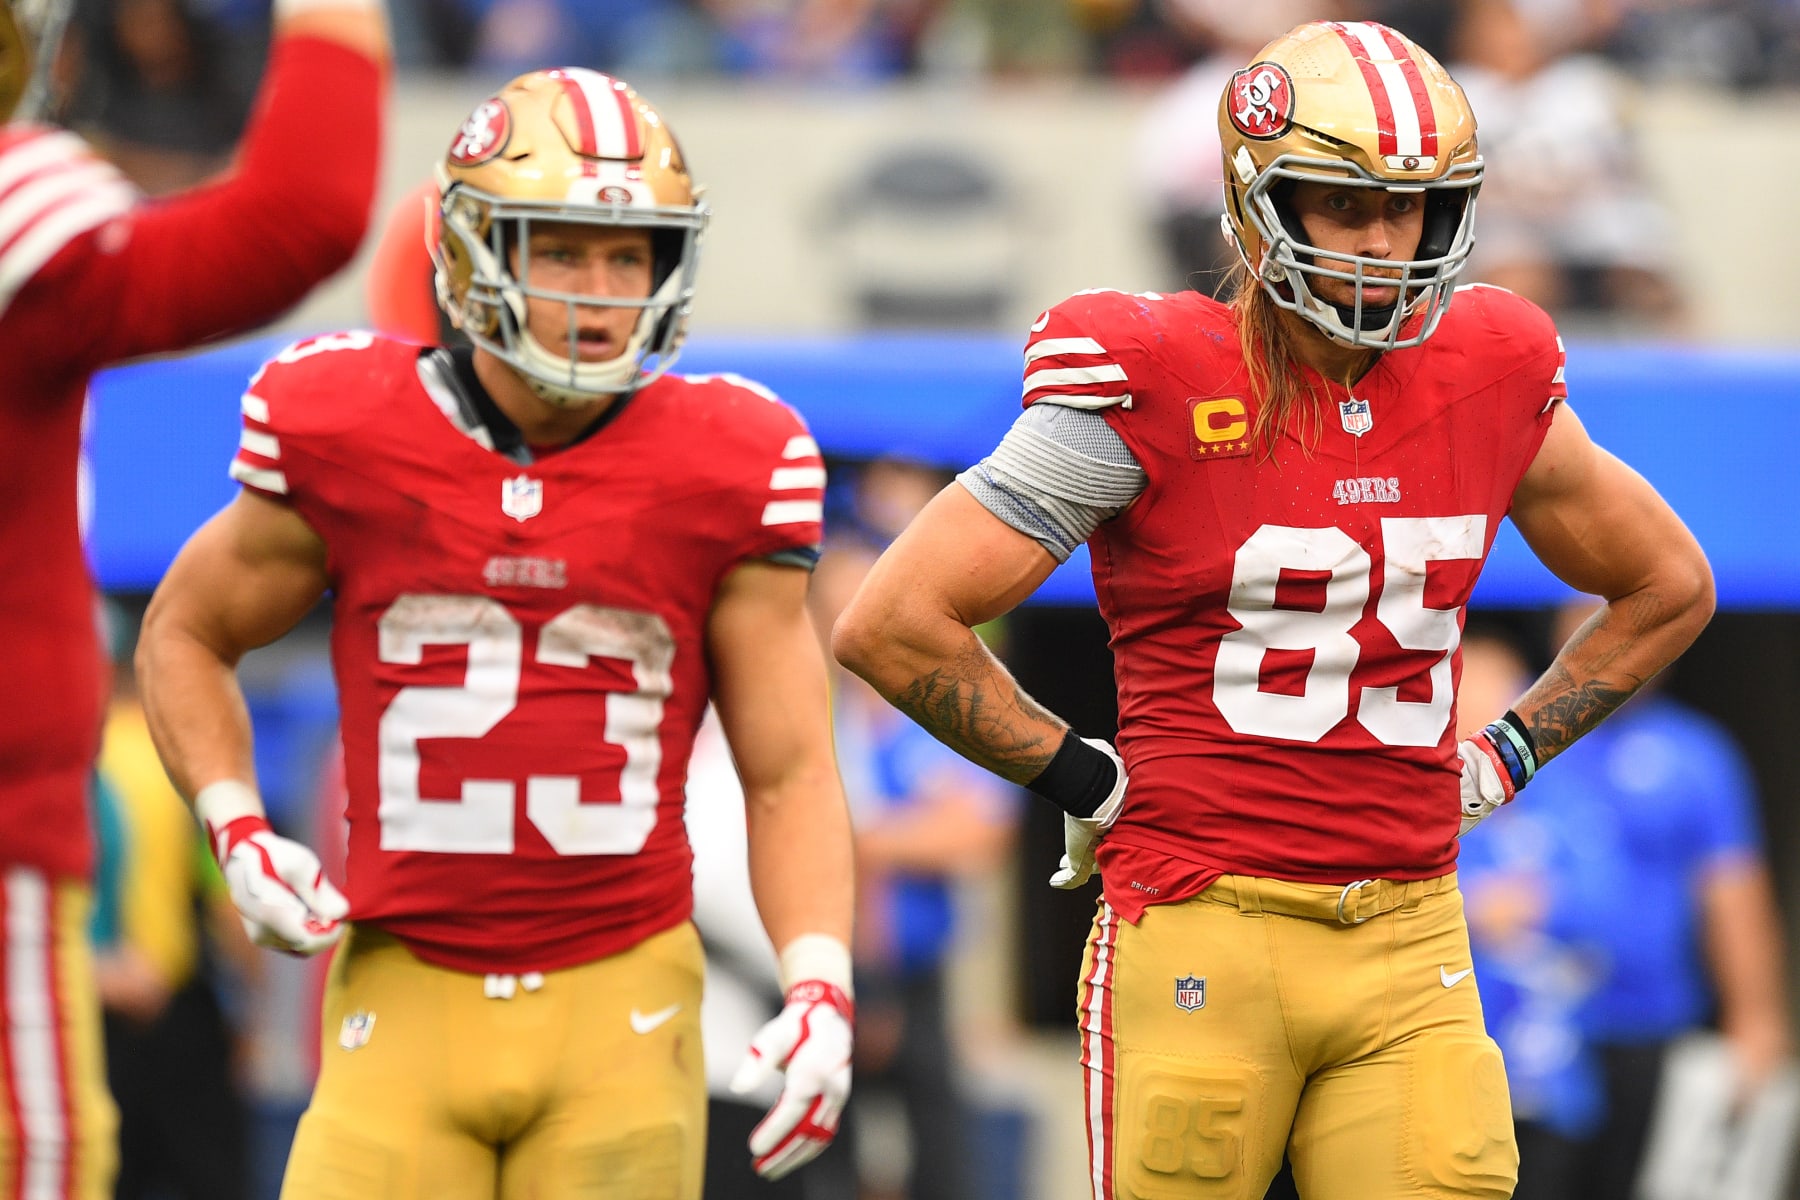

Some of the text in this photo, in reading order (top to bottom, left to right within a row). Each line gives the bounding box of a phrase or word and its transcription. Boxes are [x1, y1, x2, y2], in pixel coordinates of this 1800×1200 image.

[1193, 398, 1247, 443] C
[1346, 414, 1368, 430] NFL
[1332, 476, 1401, 505] 49ERS
[1212, 514, 1488, 747] 85
[377, 593, 677, 856] 23
[1130, 881, 1160, 896] DRI-FIT
[1179, 990, 1201, 1006] NFL
[1141, 1094, 1243, 1179] 85
